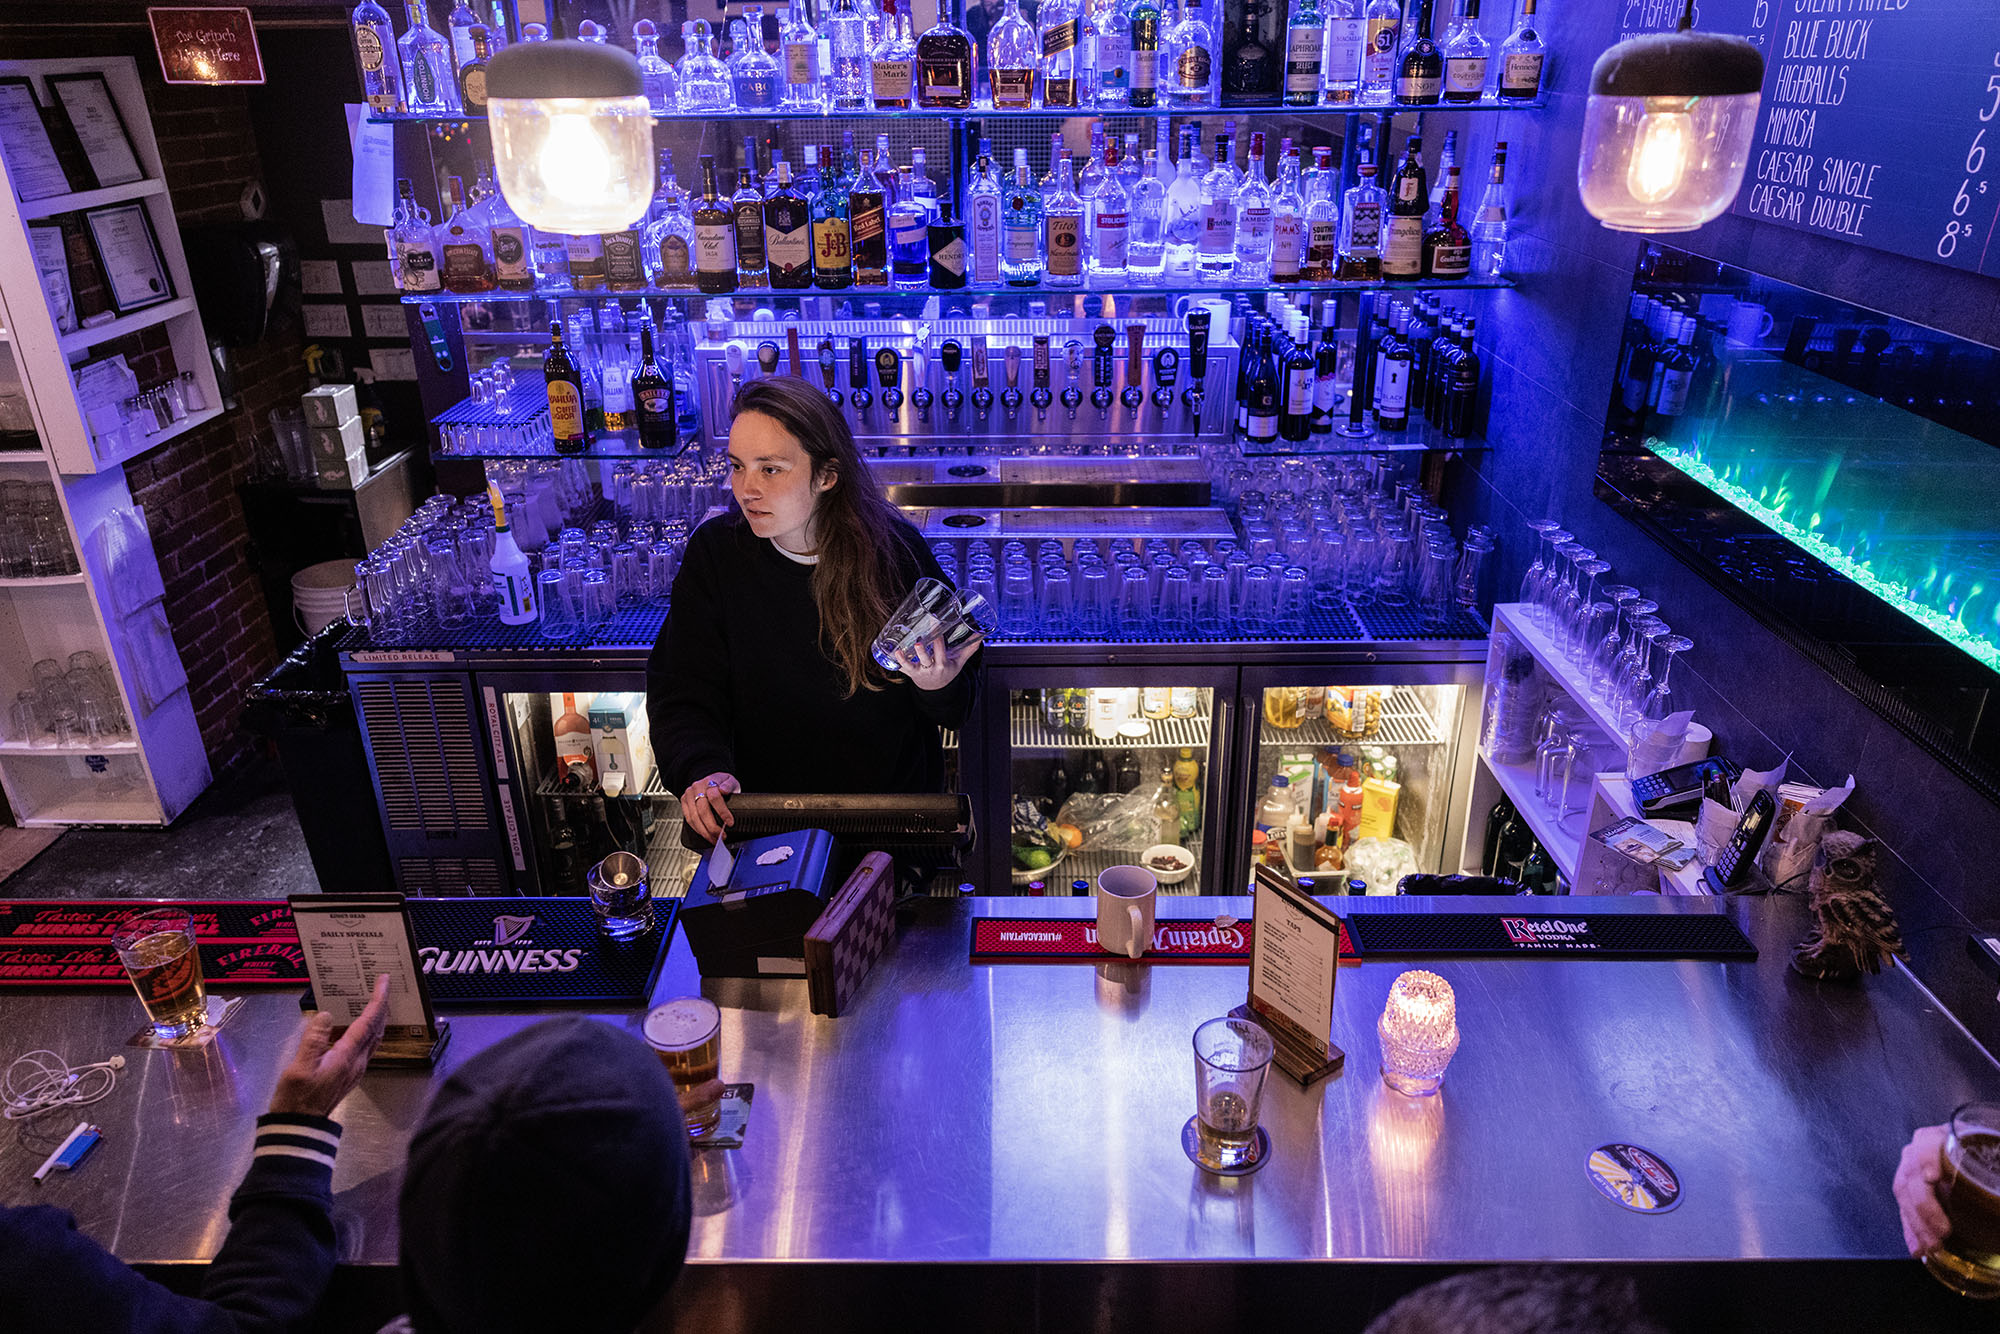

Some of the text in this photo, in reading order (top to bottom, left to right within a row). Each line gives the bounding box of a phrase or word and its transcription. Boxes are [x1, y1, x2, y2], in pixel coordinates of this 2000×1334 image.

[1668, 0, 1700, 28] CHS
[1377, 34, 1391, 46] 51
[1783, 19, 1874, 60] BLUE BUCK
[417, 58, 431, 100] HORNITOS
[873, 62, 908, 71] Maker's
[1773, 64, 1849, 105] HIGHBALLS
[1763, 107, 1986, 174] MIMOSA 6
[1757, 150, 1814, 187] CAESAR
[1818, 157, 1882, 200] SINGLE
[1749, 183, 1805, 223] CAESAR
[1809, 195, 1872, 237] DOUBLE
[697, 231, 726, 240] Canadian
[853, 217, 881, 233] Red Label
[1053, 220, 1079, 231] Tito's
[488, 703, 504, 763] ROYAL CITY ALE
[503, 800, 520, 856] ROYAL CITY ALE
[34, 908, 96, 922] Tastes
[12, 923, 104, 935] BURNS
[1000, 931, 1063, 942] #LIKEACAPTAIN
[1168, 926, 1244, 950] Captain
[1502, 919, 1588, 941] Ketel One
[216, 943, 305, 969] FIREBALL
[417, 946, 582, 974] GUINNESS
[0, 964, 64, 977] URNS
